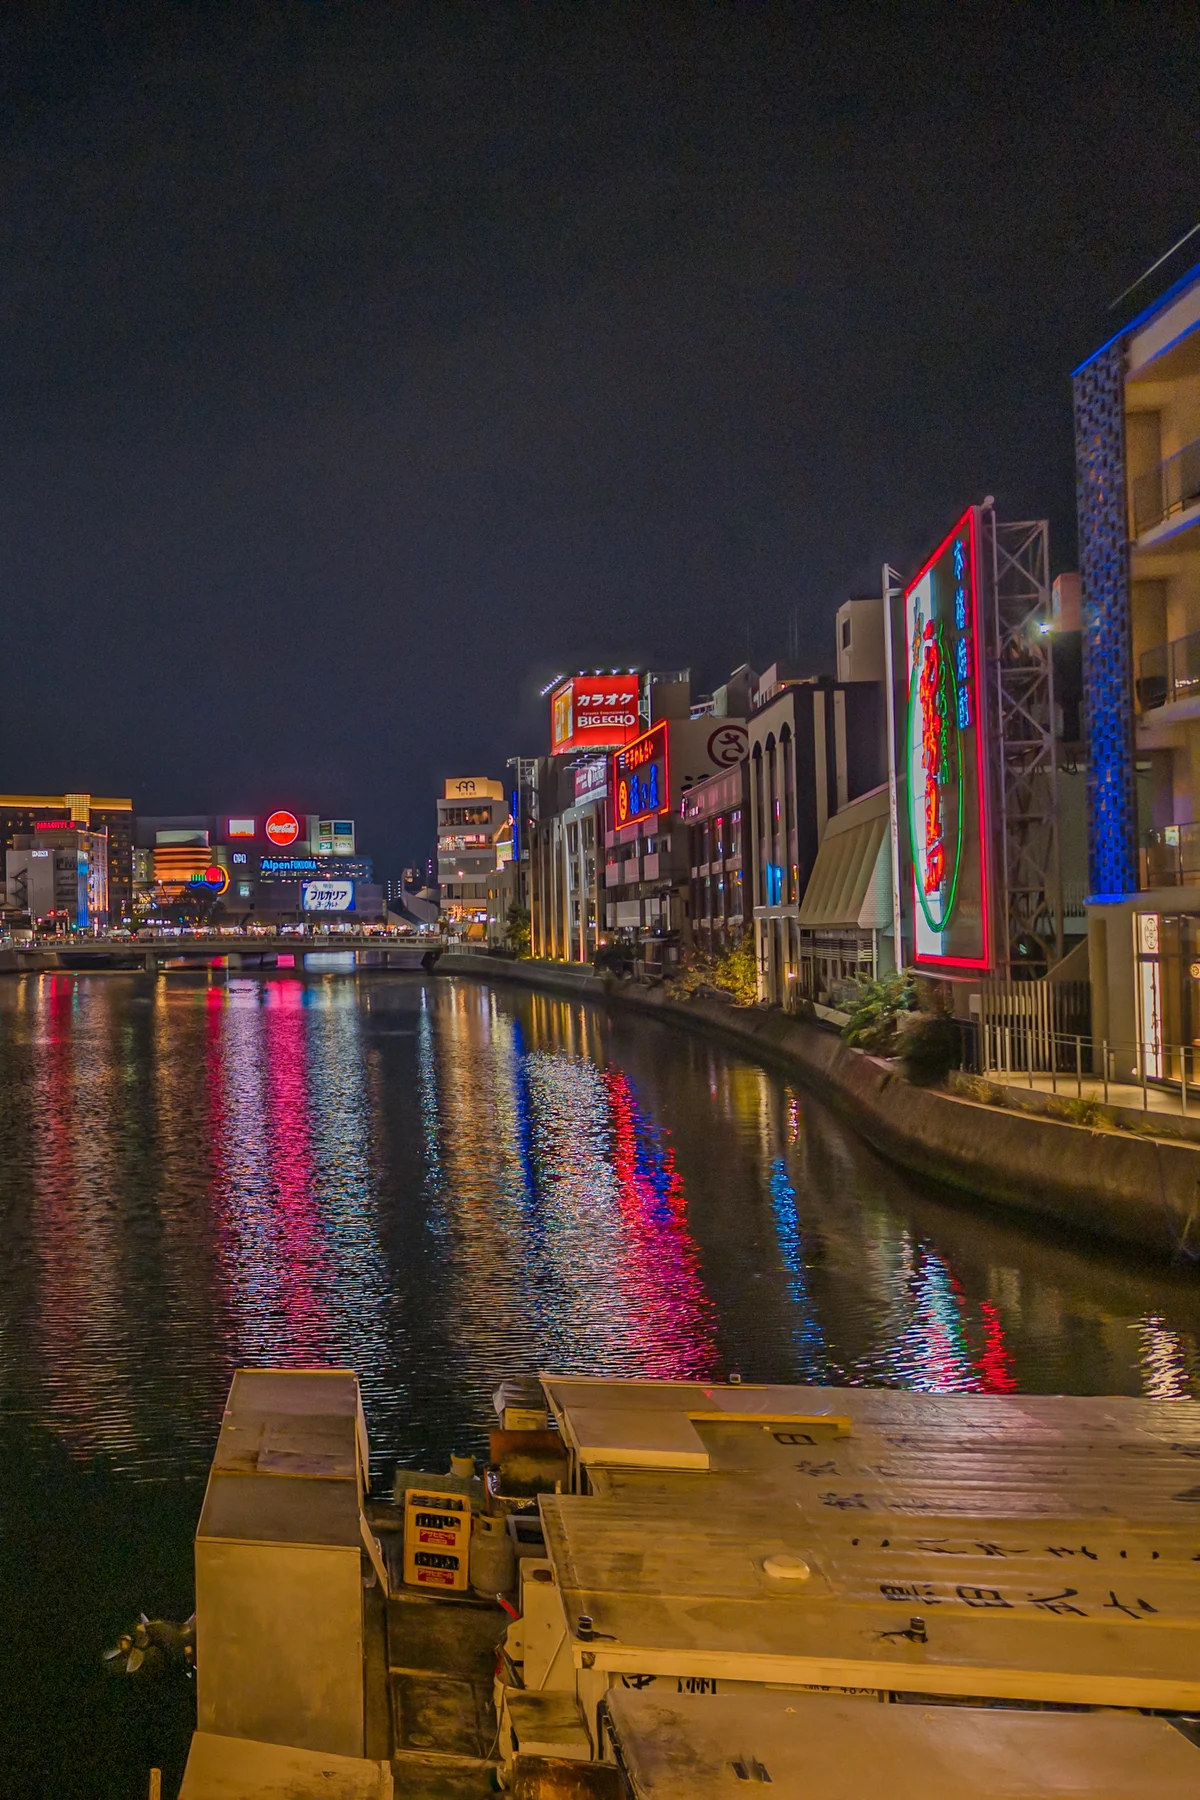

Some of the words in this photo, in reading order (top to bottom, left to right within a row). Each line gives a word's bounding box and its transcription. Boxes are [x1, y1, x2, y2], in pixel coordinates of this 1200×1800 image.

[577, 693, 634, 706] カラオケ
[577, 715, 600, 728] BIG
[602, 714, 636, 726] ECHO
[268, 822, 297, 834] Coca-Cola
[262, 859, 290, 871] Alpen
[290, 861, 317, 869] FUKUOKA
[421, 1530, 455, 1541] アサヒビール
[418, 1569, 453, 1580] アサヒビール
